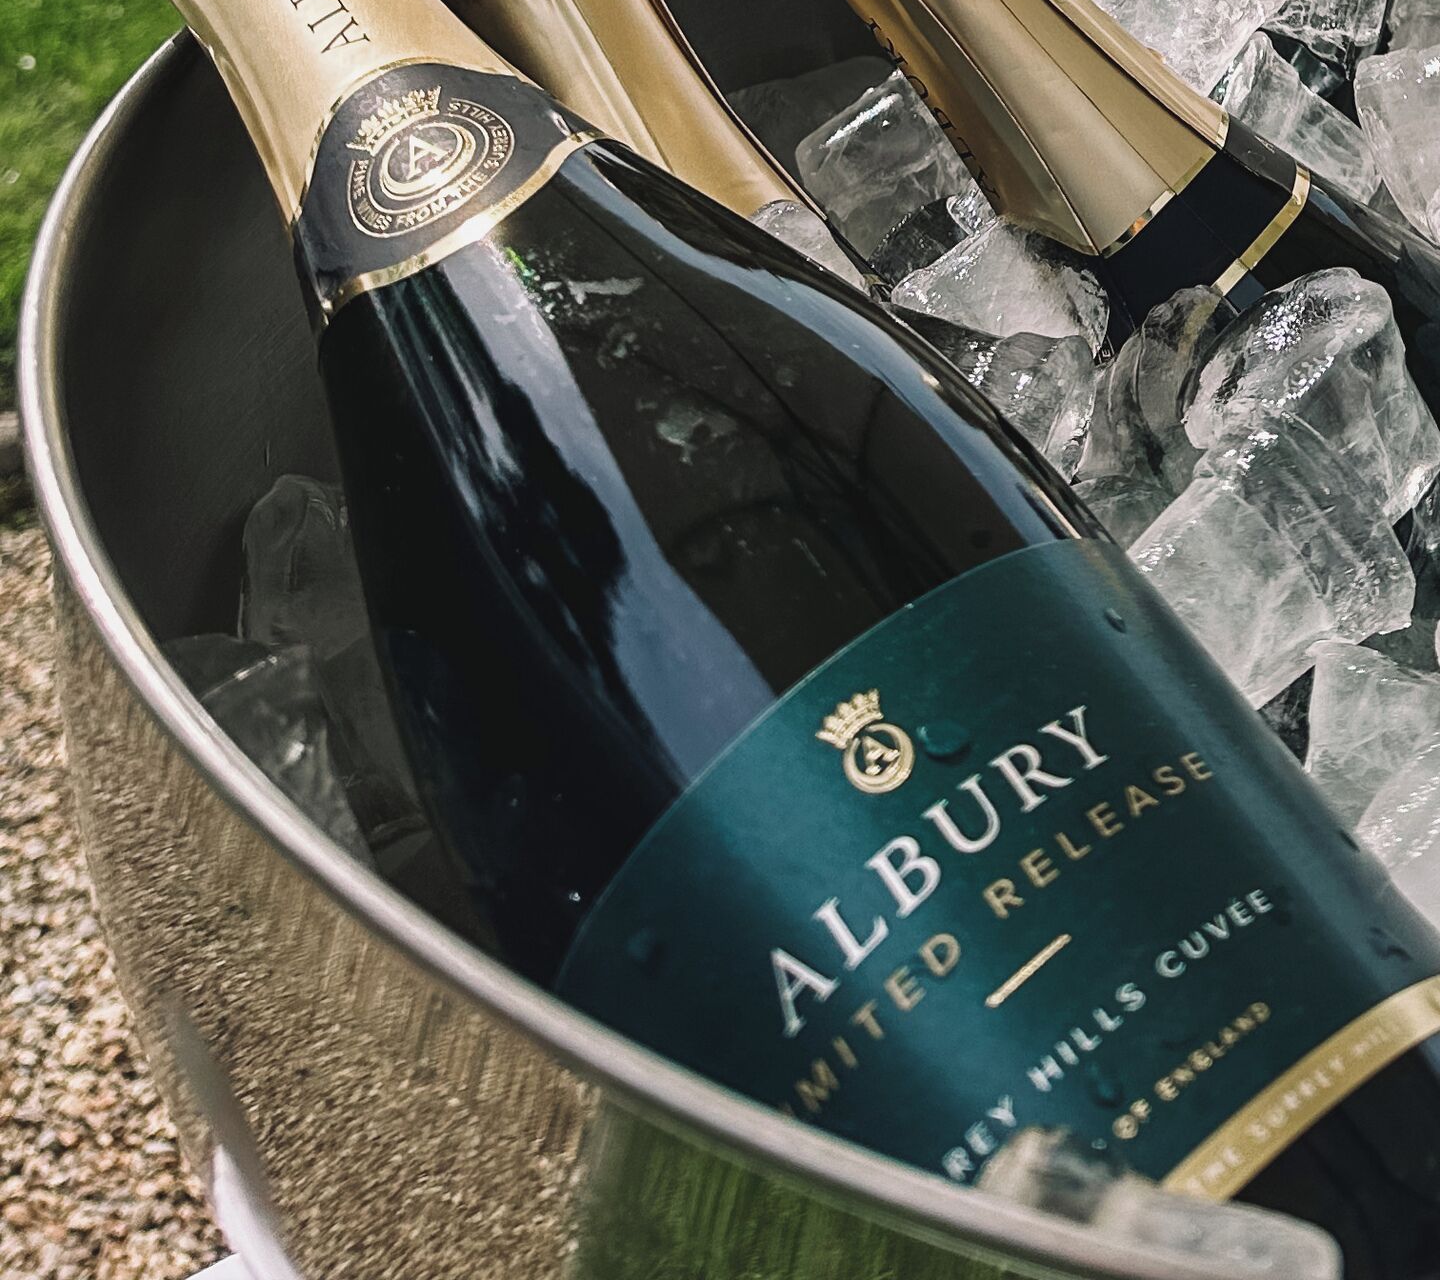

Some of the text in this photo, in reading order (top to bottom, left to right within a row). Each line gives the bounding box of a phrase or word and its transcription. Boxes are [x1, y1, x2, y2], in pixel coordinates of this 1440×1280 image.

[396, 195, 448, 228] FROM
[447, 101, 497, 125] HILLS
[406, 134, 449, 181] A
[770, 704, 1110, 1038] ALBURY
[982, 751, 1214, 919] RELEASE
[1026, 982, 1147, 1092] HILLS
[1112, 1002, 1271, 1139] OF ENGLAND
[1249, 1056, 1347, 1139] SURREY
